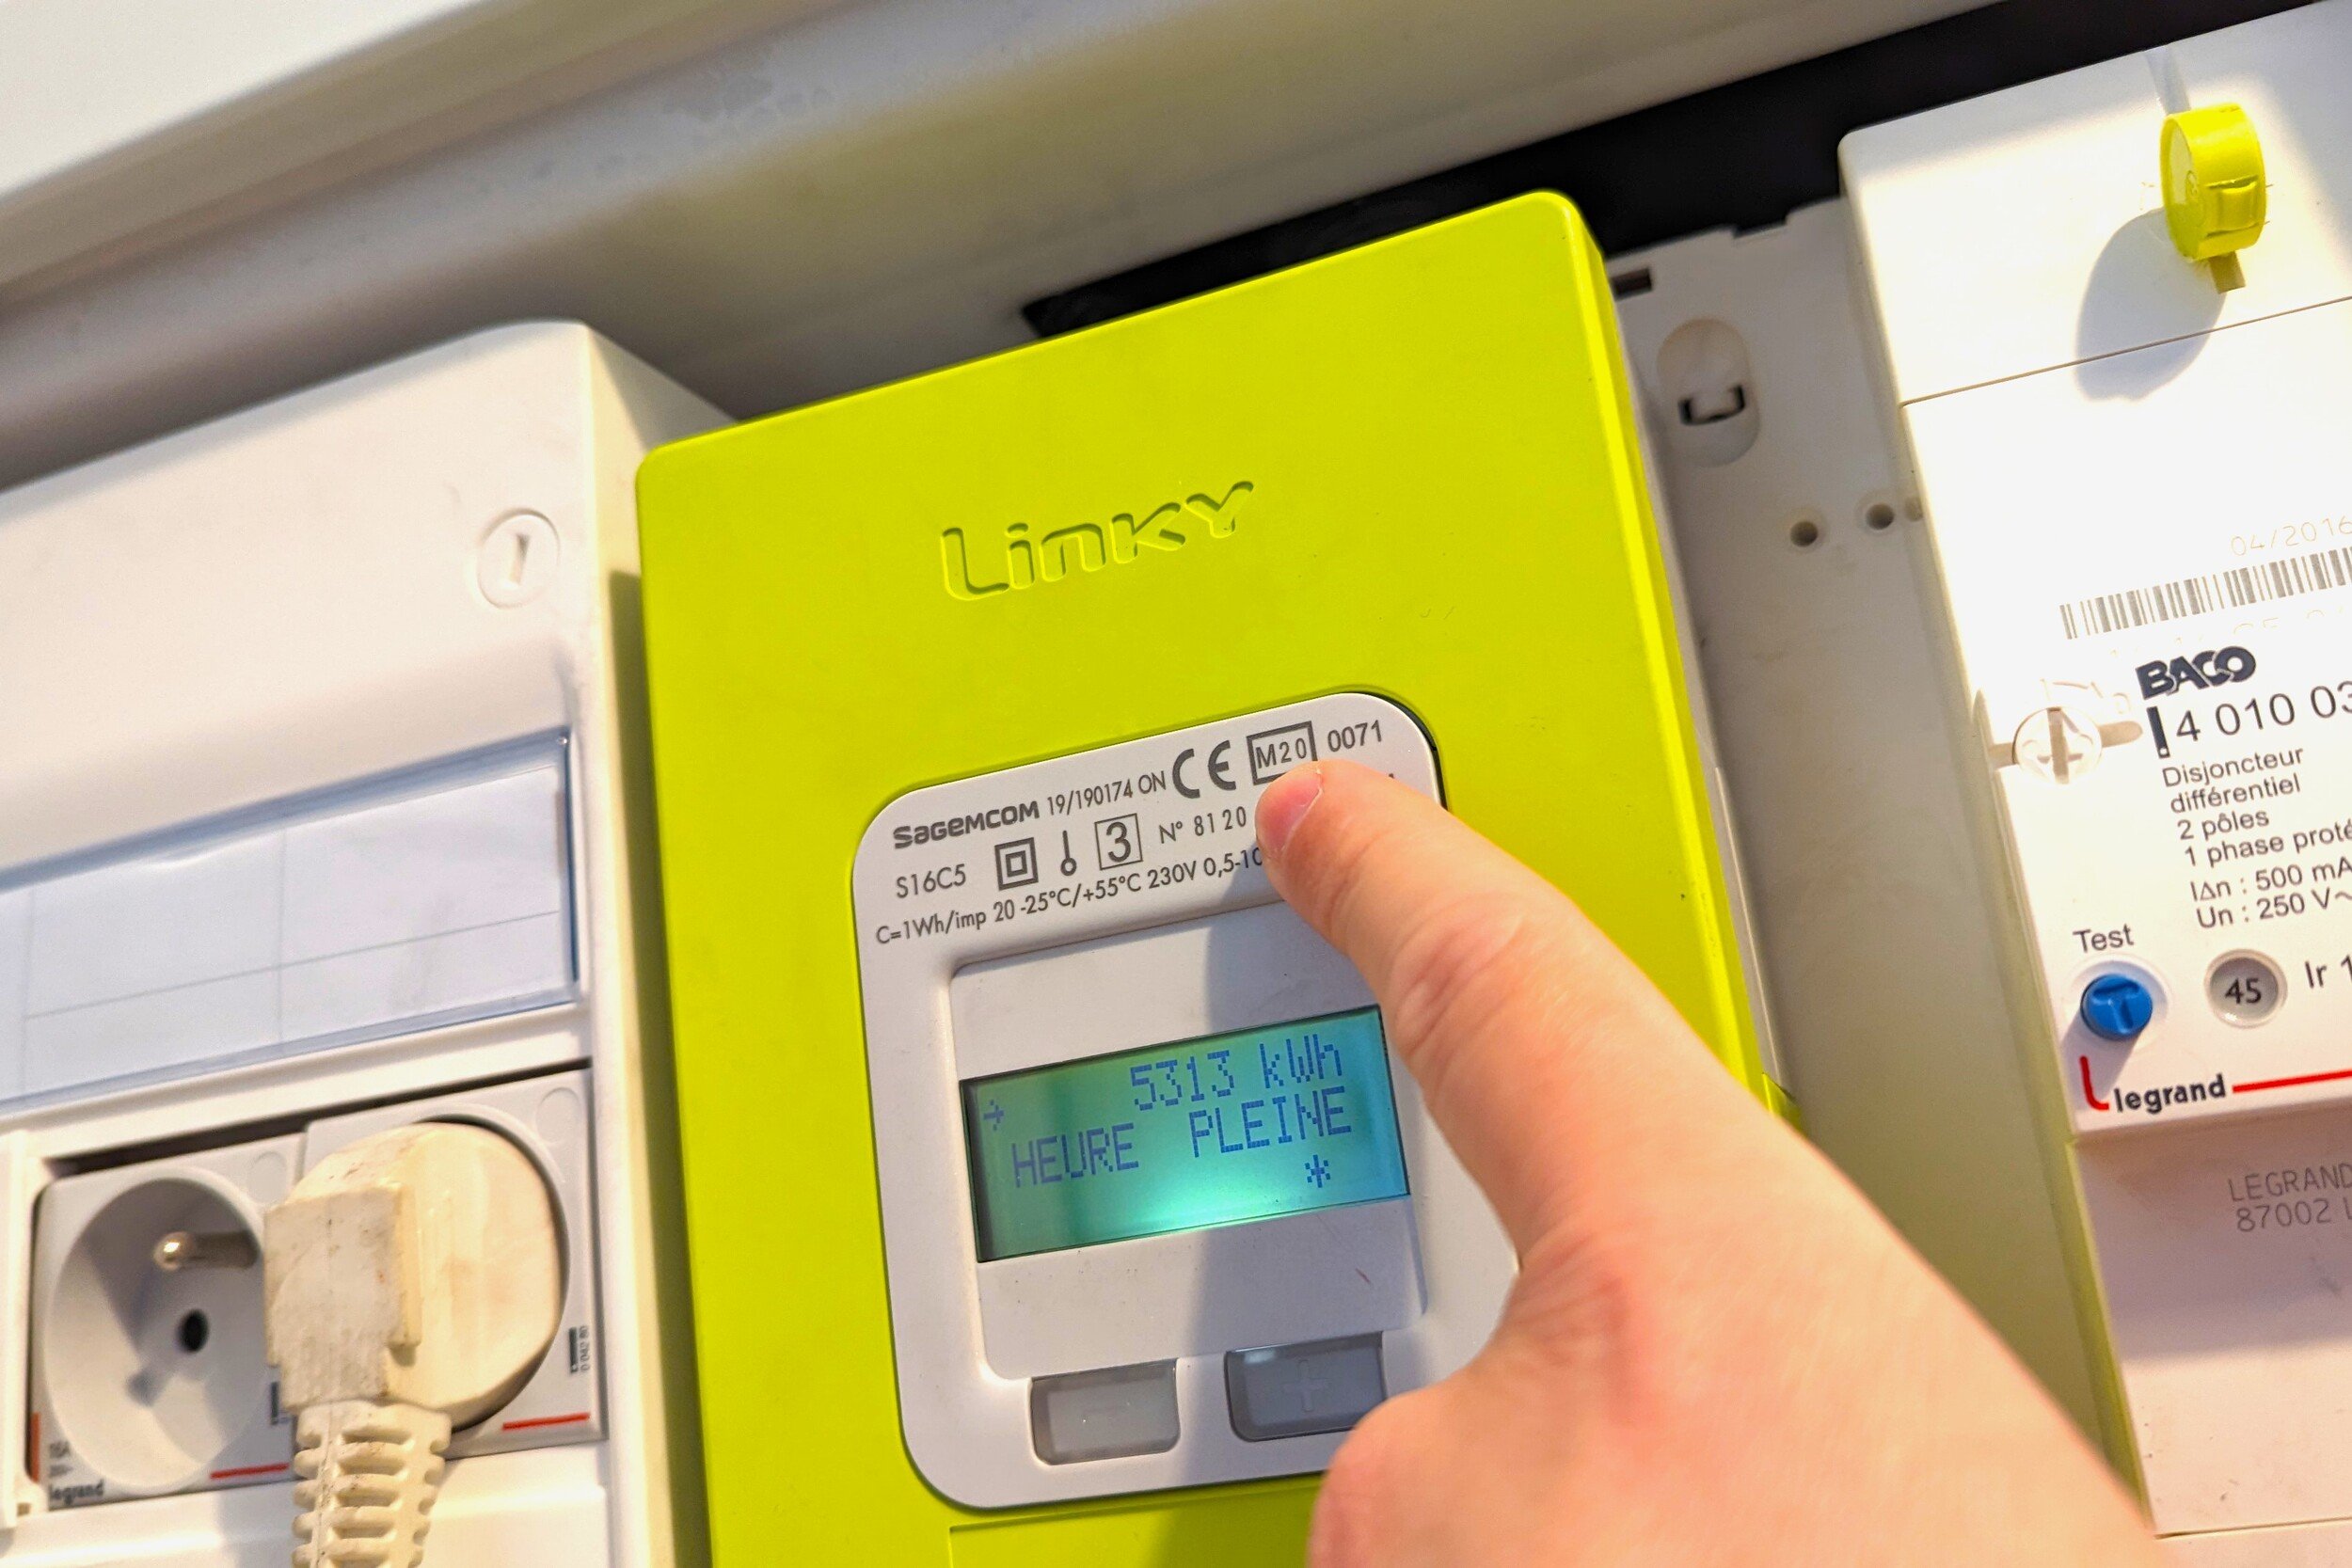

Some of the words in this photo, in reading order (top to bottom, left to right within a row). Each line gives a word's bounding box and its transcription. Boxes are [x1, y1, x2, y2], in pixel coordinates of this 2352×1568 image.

[2231, 515, 2352, 557] 04/2016
[2135, 645, 2257, 700] BACO
[2176, 710, 2201, 742] 4
[2215, 693, 2295, 736] 010
[1047, 781, 1134, 816] 19/190174
[1138, 770, 1167, 795] ON
[1255, 737, 1308, 769] M20
[1327, 720, 1383, 752] 0071
[2162, 748, 2304, 787] Disjoncteur
[2170, 773, 2301, 814] différentiel
[2177, 819, 2194, 840] 2
[2201, 810, 2270, 840] pôles
[896, 863, 967, 898] S16C5
[1105, 821, 1132, 863] 3
[2185, 847, 2196, 867] 1
[2207, 836, 2284, 868] phase
[2255, 863, 2302, 892] 500
[2312, 856, 2352, 882] mA
[876, 910, 987, 944] C=1Wh/imp
[993, 900, 1015, 923] 20
[1147, 861, 1198, 891] 230V
[2197, 906, 2233, 928] Un
[2257, 892, 2305, 920] 250
[2073, 925, 2135, 954] Test
[2224, 977, 2263, 1005] 45
[1130, 1050, 1234, 1111] 5313
[1259, 1034, 1343, 1089] kWh
[2114, 1072, 2227, 1116] legrand
[1011, 1122, 1140, 1188] HEURE
[1189, 1085, 1352, 1158] PLEINE
[2228, 1163, 2352, 1202] LEGRAND
[2236, 1196, 2332, 1232] 87002
